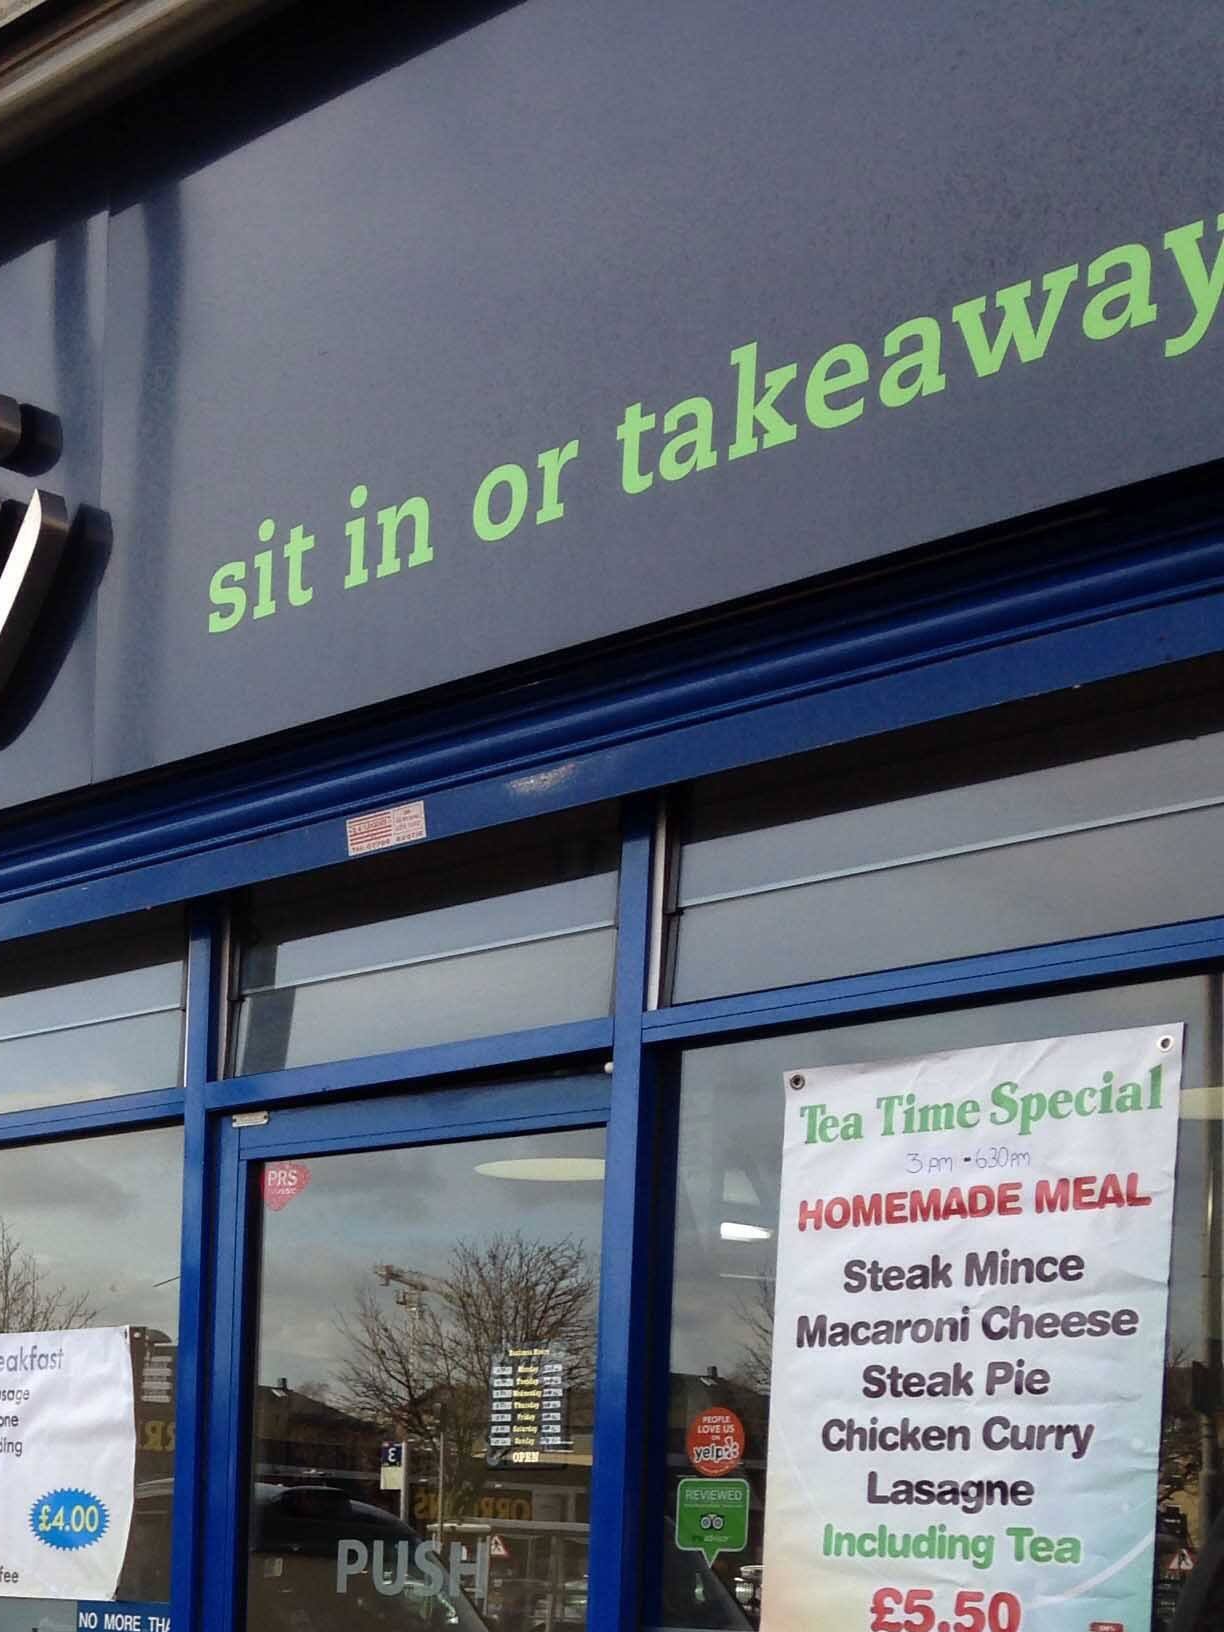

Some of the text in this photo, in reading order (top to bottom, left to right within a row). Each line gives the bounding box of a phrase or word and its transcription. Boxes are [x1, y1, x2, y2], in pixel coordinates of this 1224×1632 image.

[207, 211, 1224, 634] sit in or takeaway
[799, 1063, 1164, 1146] Tea Time Special
[268, 1170, 297, 1186] PRS
[797, 1172, 1153, 1232] HOMEMADE MEAL
[843, 1248, 1086, 1294] Steak Mince
[795, 1304, 1140, 1349] Macaroni Cheese
[861, 1358, 1051, 1400] Steak Pie
[697, 1424, 736, 1434] LOVE US
[821, 1414, 1096, 1460] Chicken Curry
[512, 1451, 540, 1463] OPEN
[694, 1444, 725, 1462] yelp
[685, 1489, 743, 1501] REVIEWED
[866, 1470, 1035, 1515] Lasagne
[38, 1504, 99, 1533] £4.00
[336, 1537, 488, 1599] PUSH
[822, 1522, 1082, 1569] Including Tea
[78, 1611, 98, 1629] NO
[103, 1613, 142, 1632] MORE
